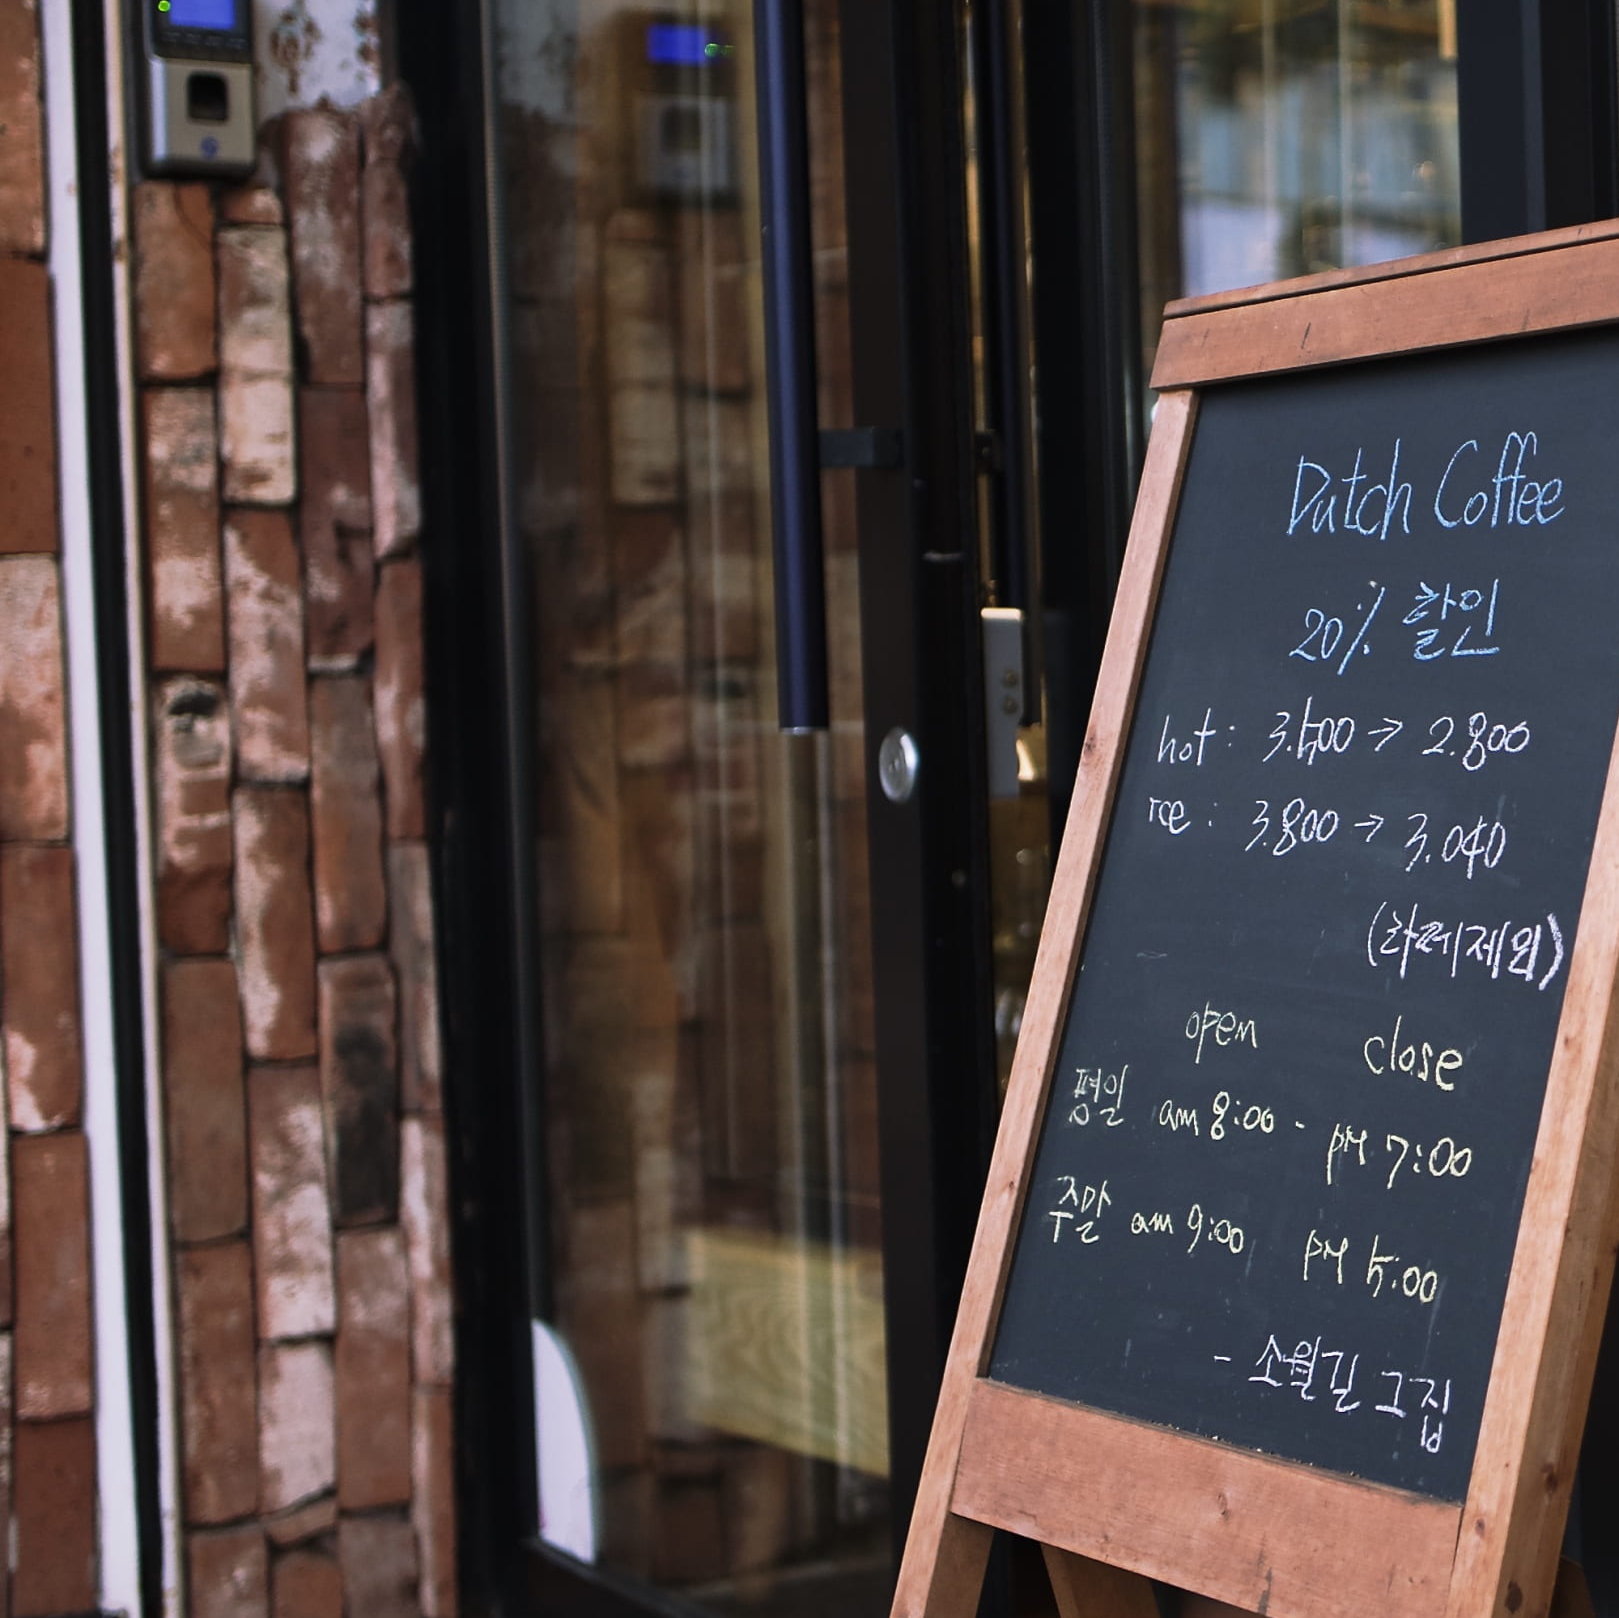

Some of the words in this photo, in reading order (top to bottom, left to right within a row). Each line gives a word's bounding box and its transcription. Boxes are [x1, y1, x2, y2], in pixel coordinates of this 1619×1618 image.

[1287, 437, 1412, 540] Dutch
[1434, 431, 1565, 528] Coffee
[1289, 585, 1386, 675] 20%
[1402, 578, 1500, 661] 할인
[1422, 712, 1531, 771] 2.800
[1245, 797, 1339, 856] 3.800
[1404, 813, 1507, 880] 3.040
[1185, 1001, 1258, 1064] open
[1364, 1015, 1463, 1091] close
[1068, 1065, 1129, 1126] 평일
[1159, 1099, 1199, 1136] am
[1210, 1091, 1275, 1140] 8:00
[1386, 1133, 1472, 1190] 7:00
[1049, 1175, 1112, 1244] 주말
[1130, 1212, 1173, 1235] am
[1187, 1203, 1244, 1254] 9:00
[1366, 1234, 1438, 1303] 5:00
[1248, 1333, 1361, 1413] 소월길
